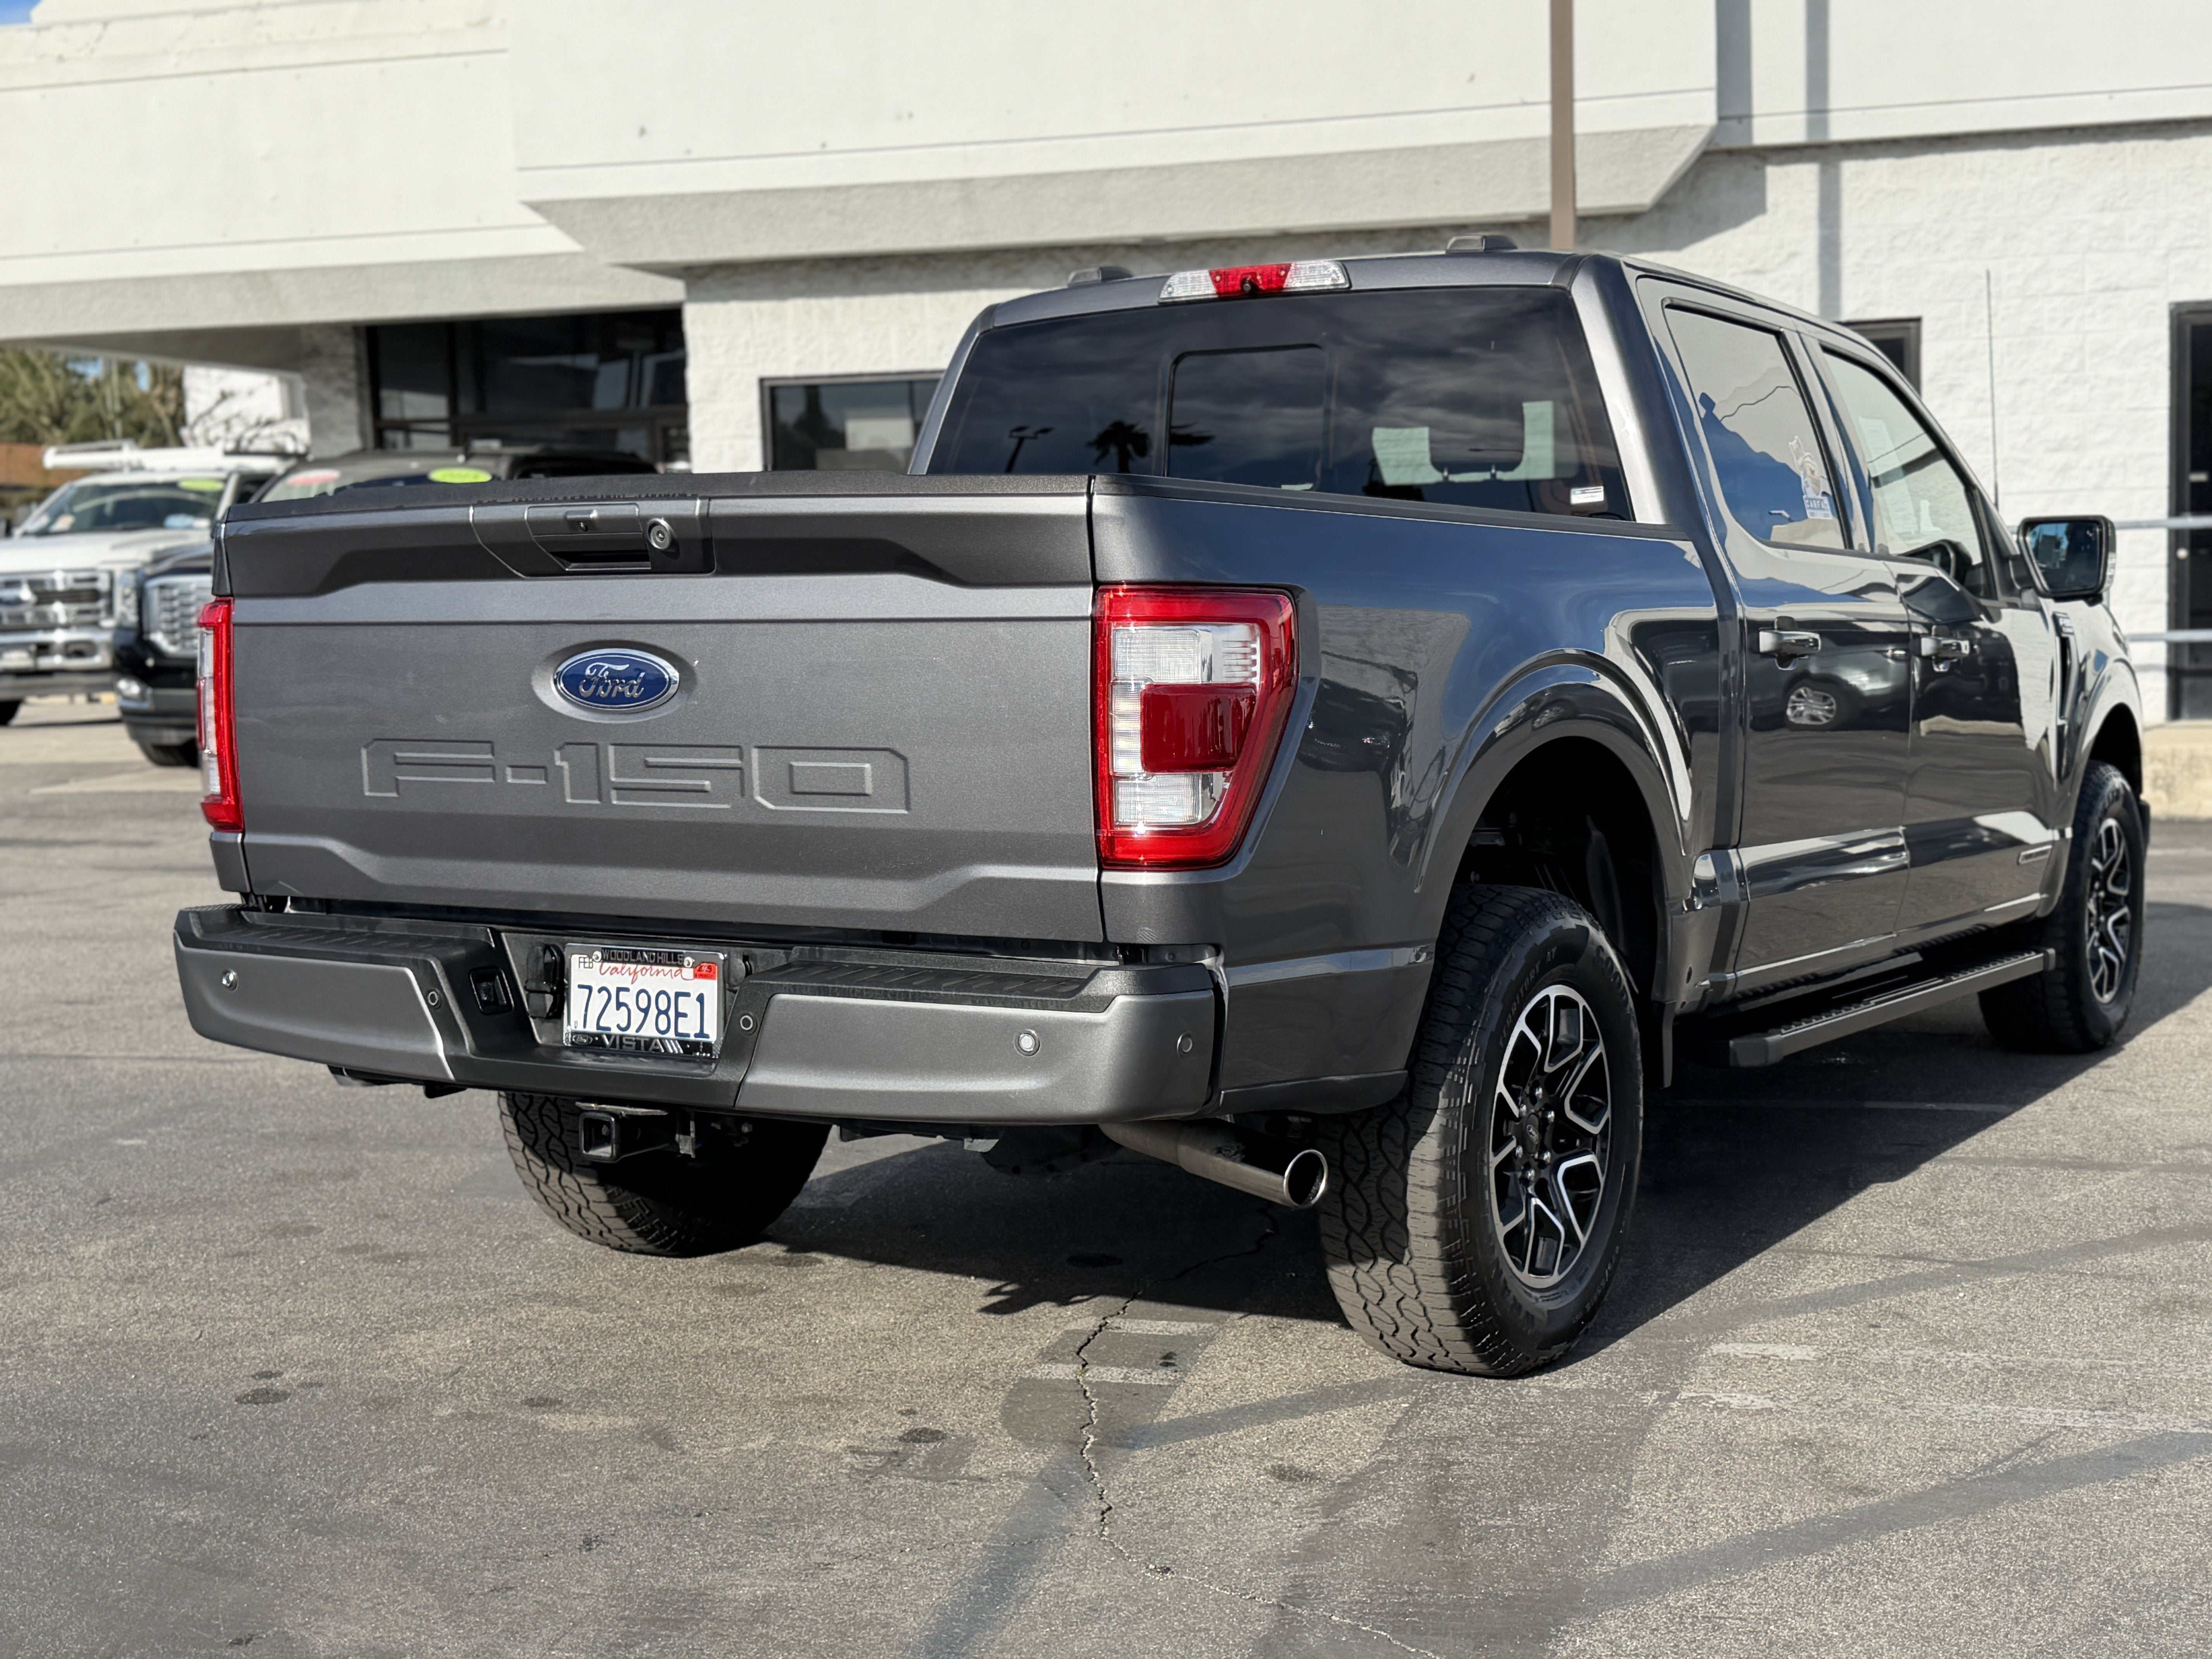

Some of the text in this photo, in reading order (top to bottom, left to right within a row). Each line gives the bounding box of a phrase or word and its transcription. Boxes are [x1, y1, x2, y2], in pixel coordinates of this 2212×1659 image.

[579, 662, 646, 697] Ford
[361, 738, 909, 814] F-150
[579, 956, 593, 969] FEB
[602, 948, 684, 965] WOODLAND HILLS
[599, 962, 694, 984] California
[577, 984, 710, 1039] 72598E1
[601, 1034, 665, 1053] VISTA
